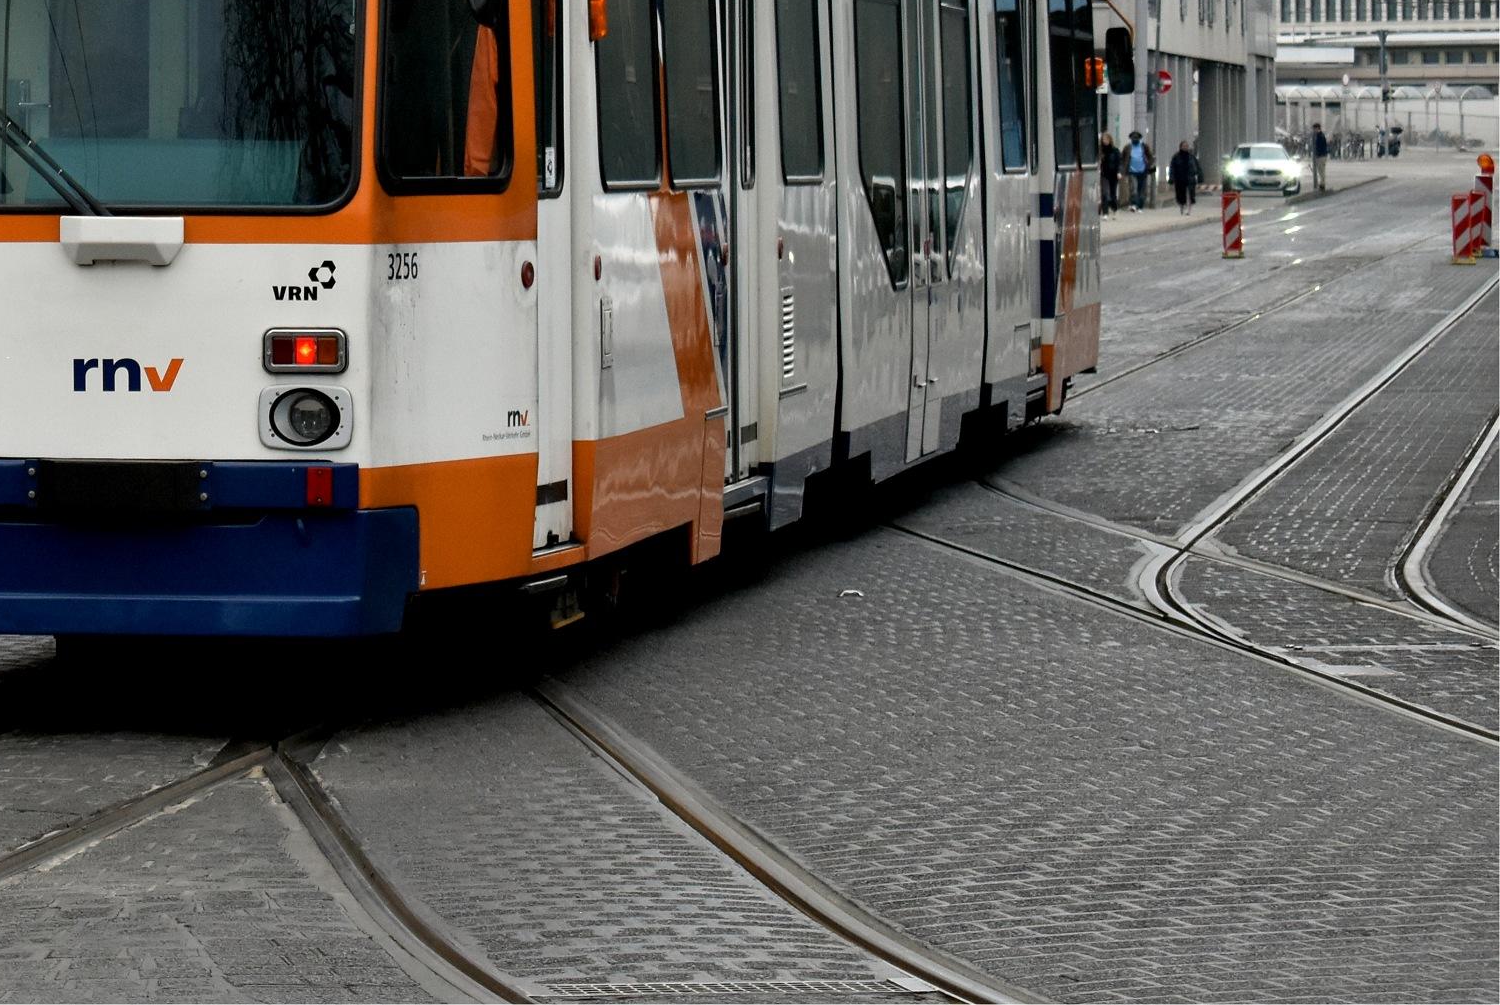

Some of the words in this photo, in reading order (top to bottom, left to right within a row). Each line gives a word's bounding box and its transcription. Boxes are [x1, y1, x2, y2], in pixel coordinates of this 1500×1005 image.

[387, 252, 419, 281] 3256
[272, 285, 318, 301] VRN
[73, 358, 185, 392] rnv
[507, 409, 529, 427] rnv
